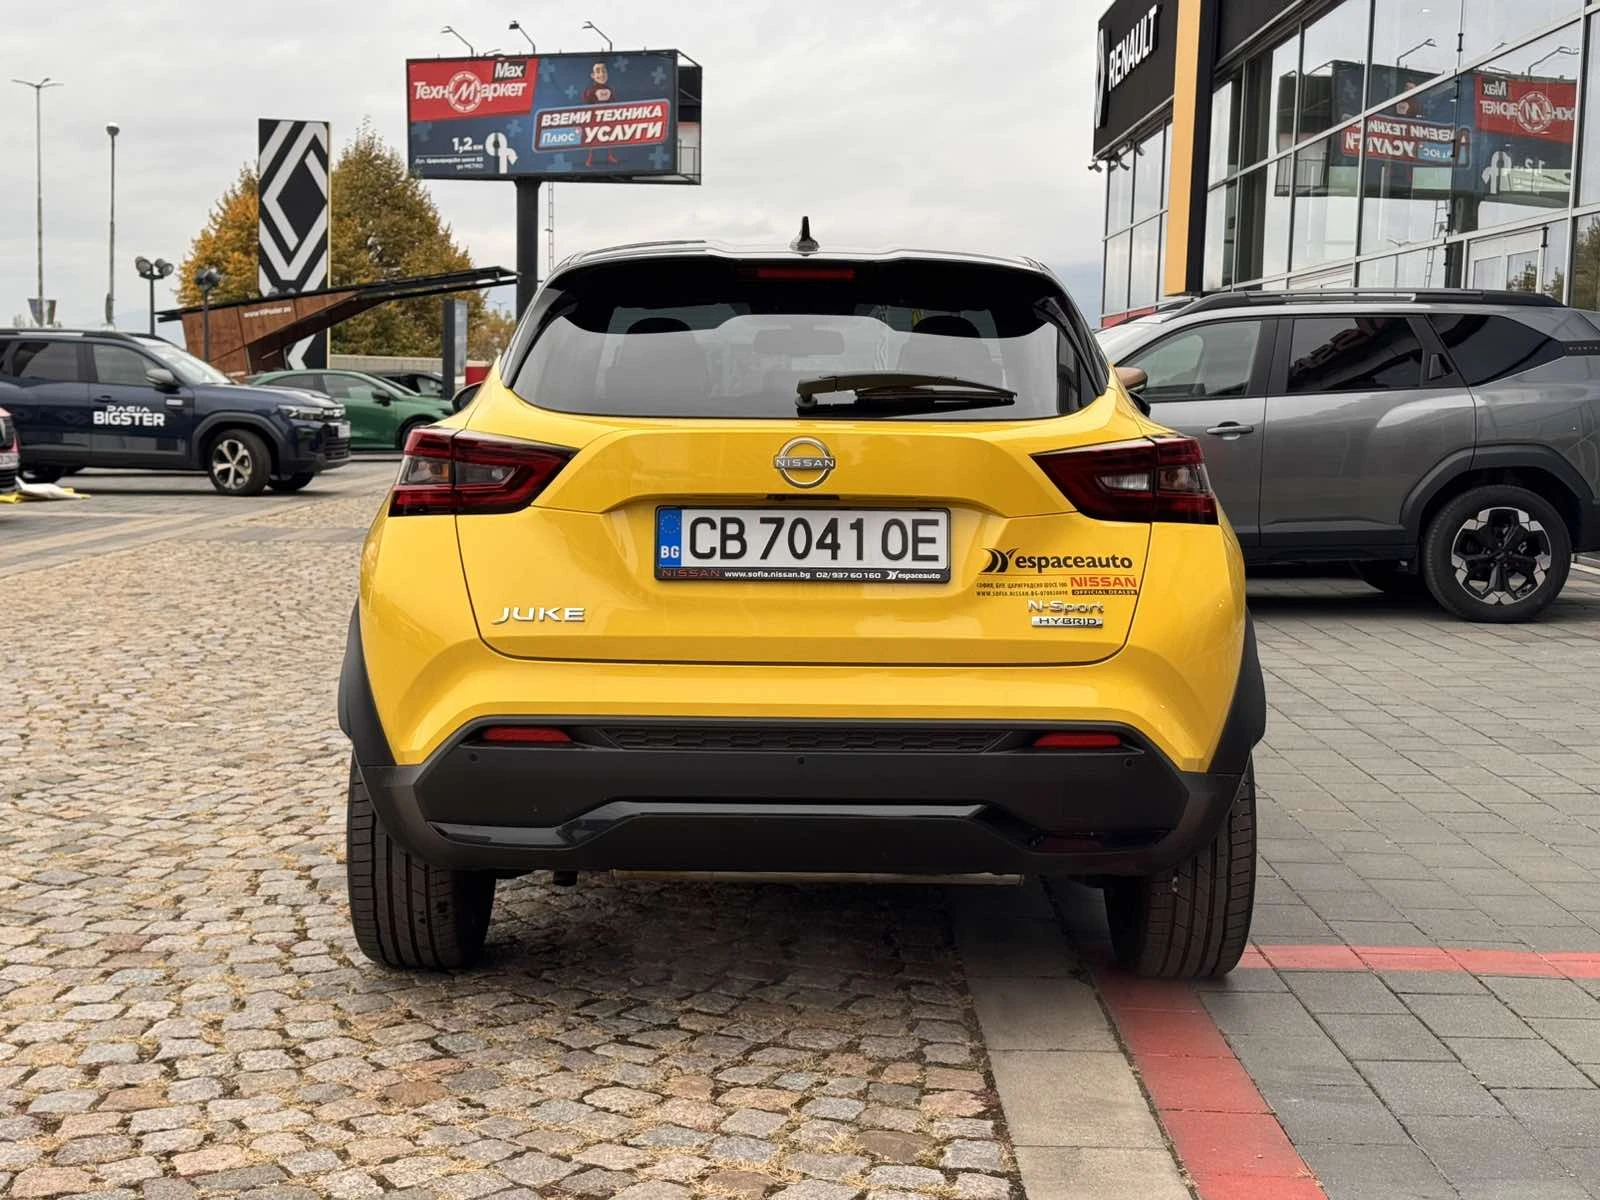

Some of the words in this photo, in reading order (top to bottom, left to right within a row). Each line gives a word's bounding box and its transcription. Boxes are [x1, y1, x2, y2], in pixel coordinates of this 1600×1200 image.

[1108, 4, 1157, 91] RENAULT
[495, 61, 524, 79] Max
[541, 110, 592, 127] ВЗЕМИ
[595, 105, 663, 122] ТЕХНИКА
[584, 122, 663, 143] УСЛУГИ
[452, 137, 473, 153] 1,2
[93, 411, 165, 427] BIGSTER
[776, 458, 835, 468] NISSAN
[689, 516, 748, 560] CB
[759, 517, 864, 561] 7041
[660, 546, 680, 559] BG
[1014, 554, 1133, 573] espaceauto
[661, 569, 720, 577] NISSAN
[724, 570, 811, 579] www.sofia.nissan.bg
[1070, 576, 1137, 588] NISSAN
[491, 607, 586, 625] JUKE
[1028, 600, 1105, 616] N-Sport
[1039, 617, 1097, 625] HYBRID
